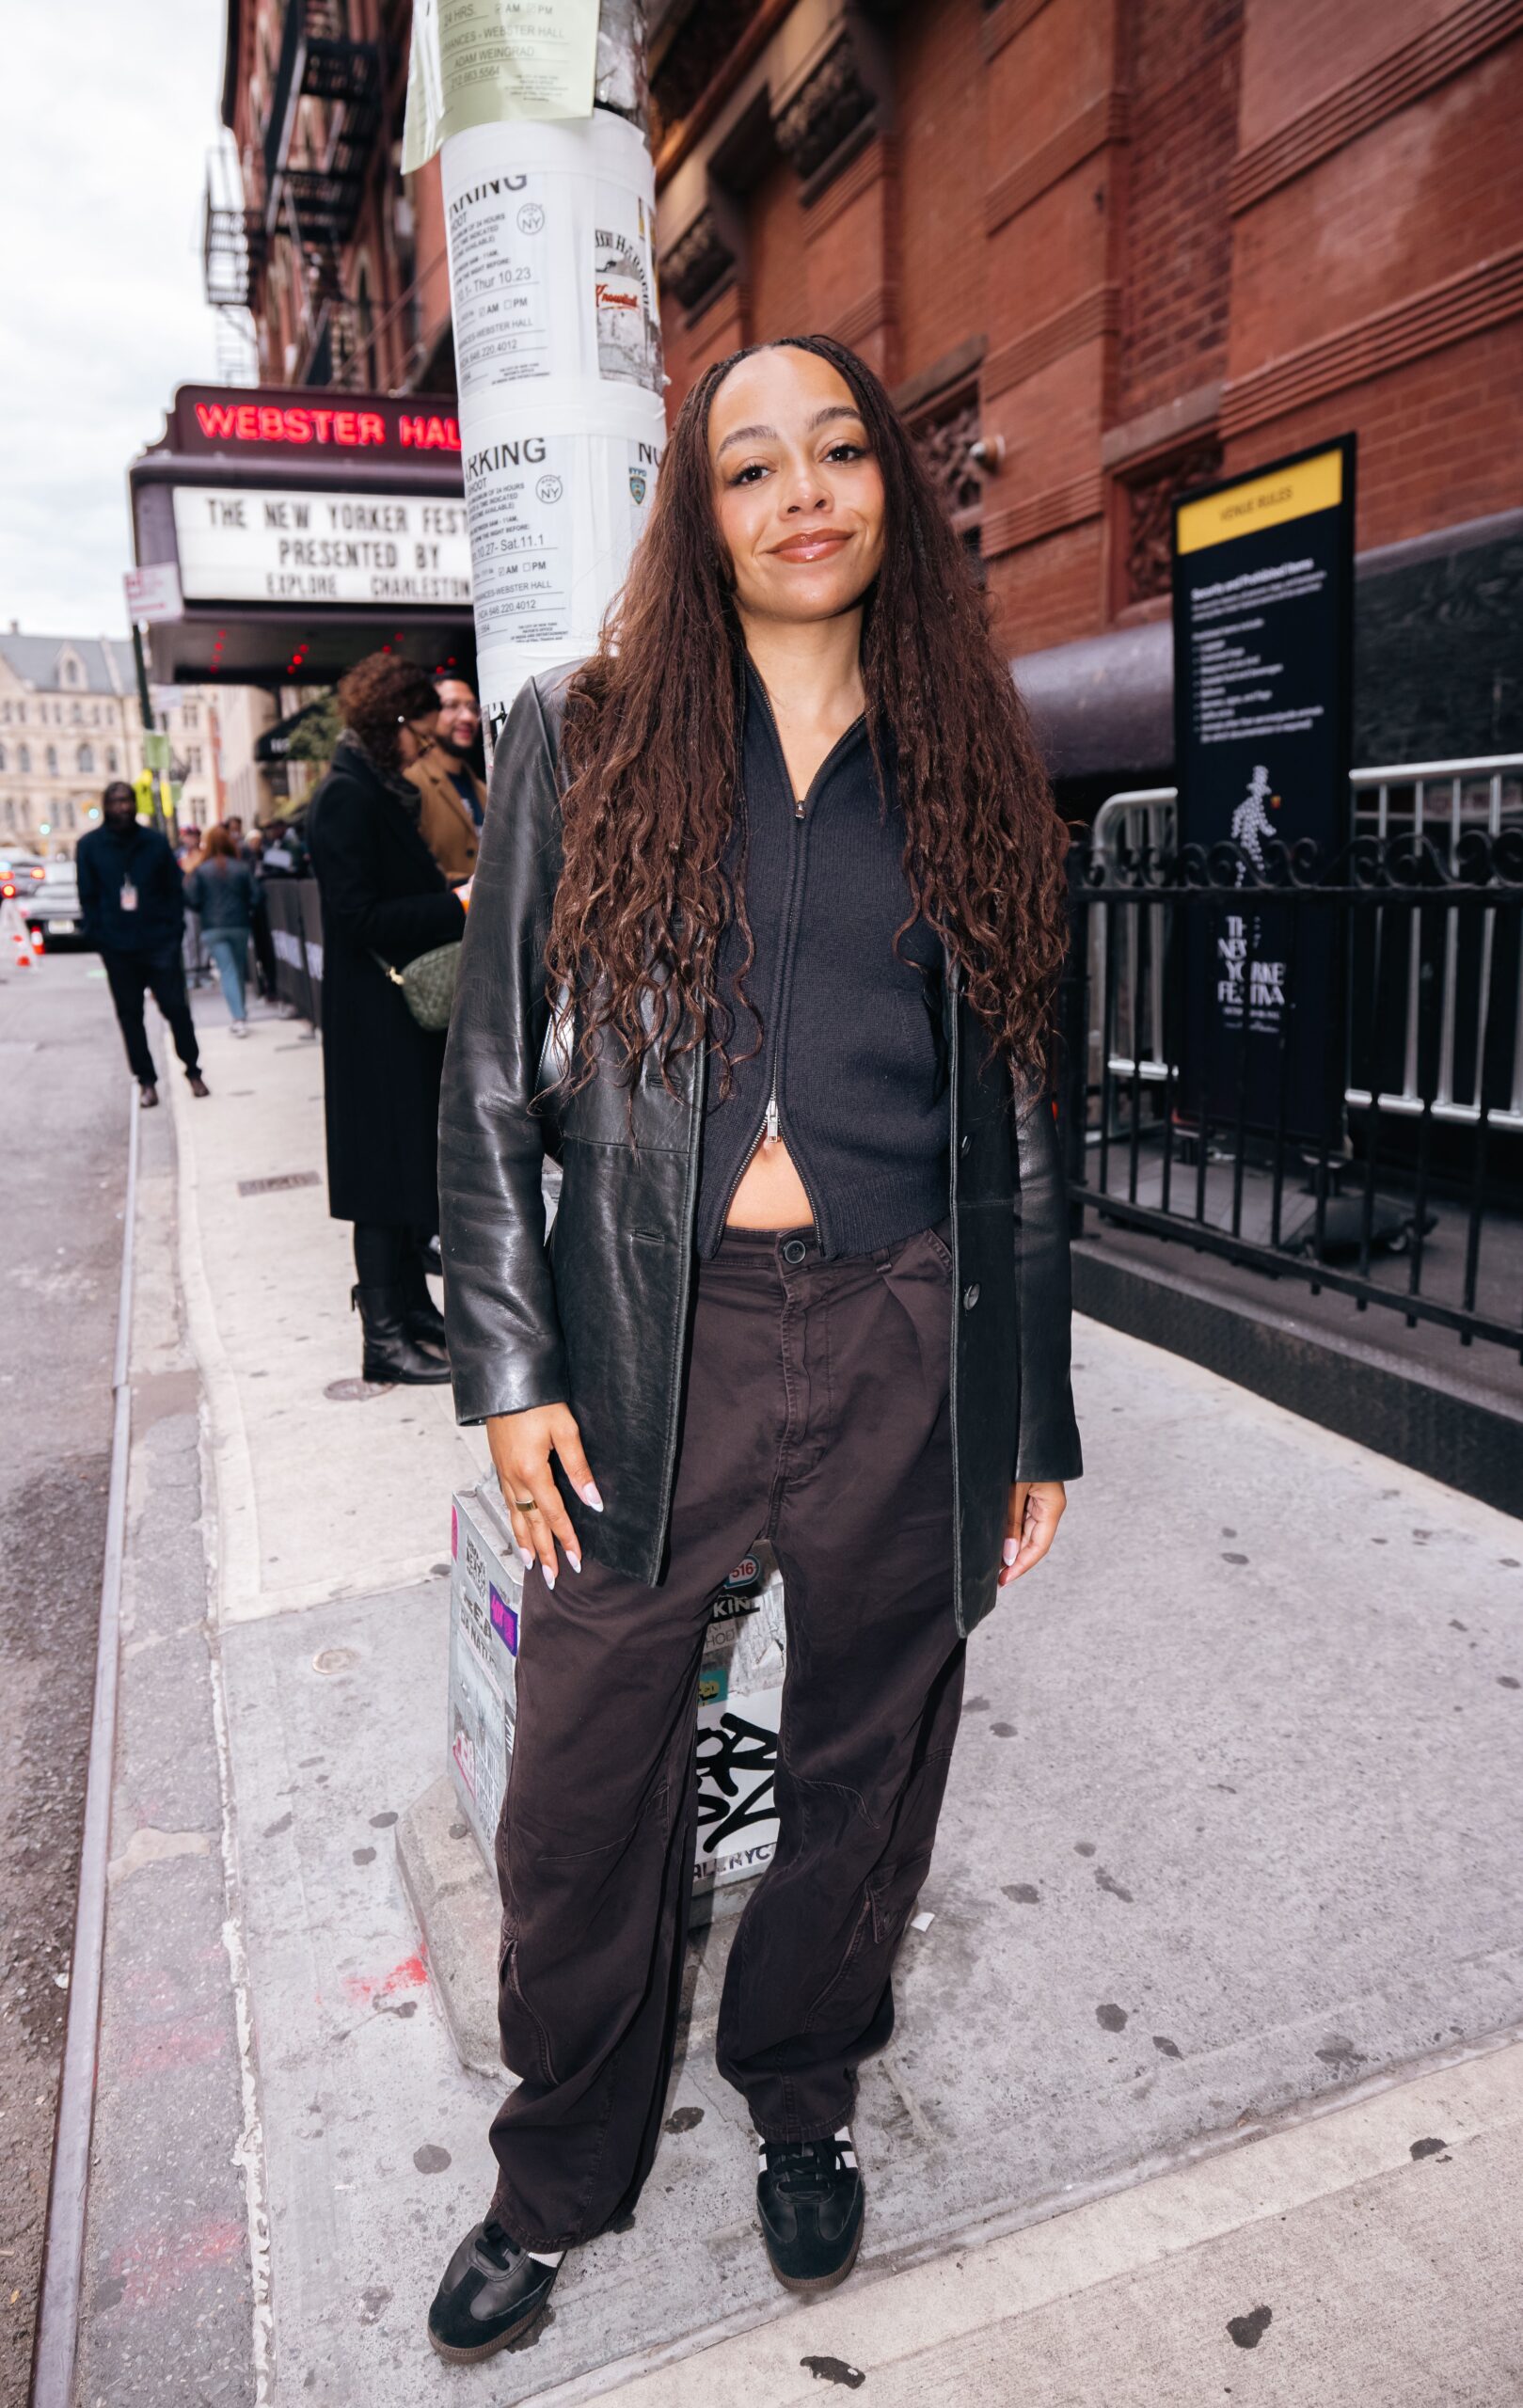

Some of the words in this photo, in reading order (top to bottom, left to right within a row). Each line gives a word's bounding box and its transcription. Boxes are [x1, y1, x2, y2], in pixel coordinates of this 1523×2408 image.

[505, 4, 520, 13] AM
[538, 5, 553, 15] PM
[483, 24, 535, 39] WEBSTER
[538, 26, 564, 39] HALL
[479, 45, 535, 61] WEINGRAD
[486, 303, 500, 314] AM
[513, 297, 528, 308] PM
[512, 318, 532, 328] HALL
[195, 403, 385, 446] WEBSTER
[399, 415, 462, 451] HAL
[1220, 499, 1254, 523] VENUE
[1257, 485, 1293, 509] RULES
[206, 498, 246, 528] THE
[264, 501, 309, 529] NEW
[328, 502, 407, 532] YORKER
[422, 506, 469, 535] FEST
[279, 539, 397, 569] PRESENTED
[416, 542, 440, 570] BY
[506, 564, 518, 575] AM
[532, 561, 547, 571] PM
[266, 572, 337, 596] EXPLORE
[371, 576, 469, 598] CHARLESTON
[531, 580, 552, 589] HALL
[732, 1562, 755, 1578] 516
